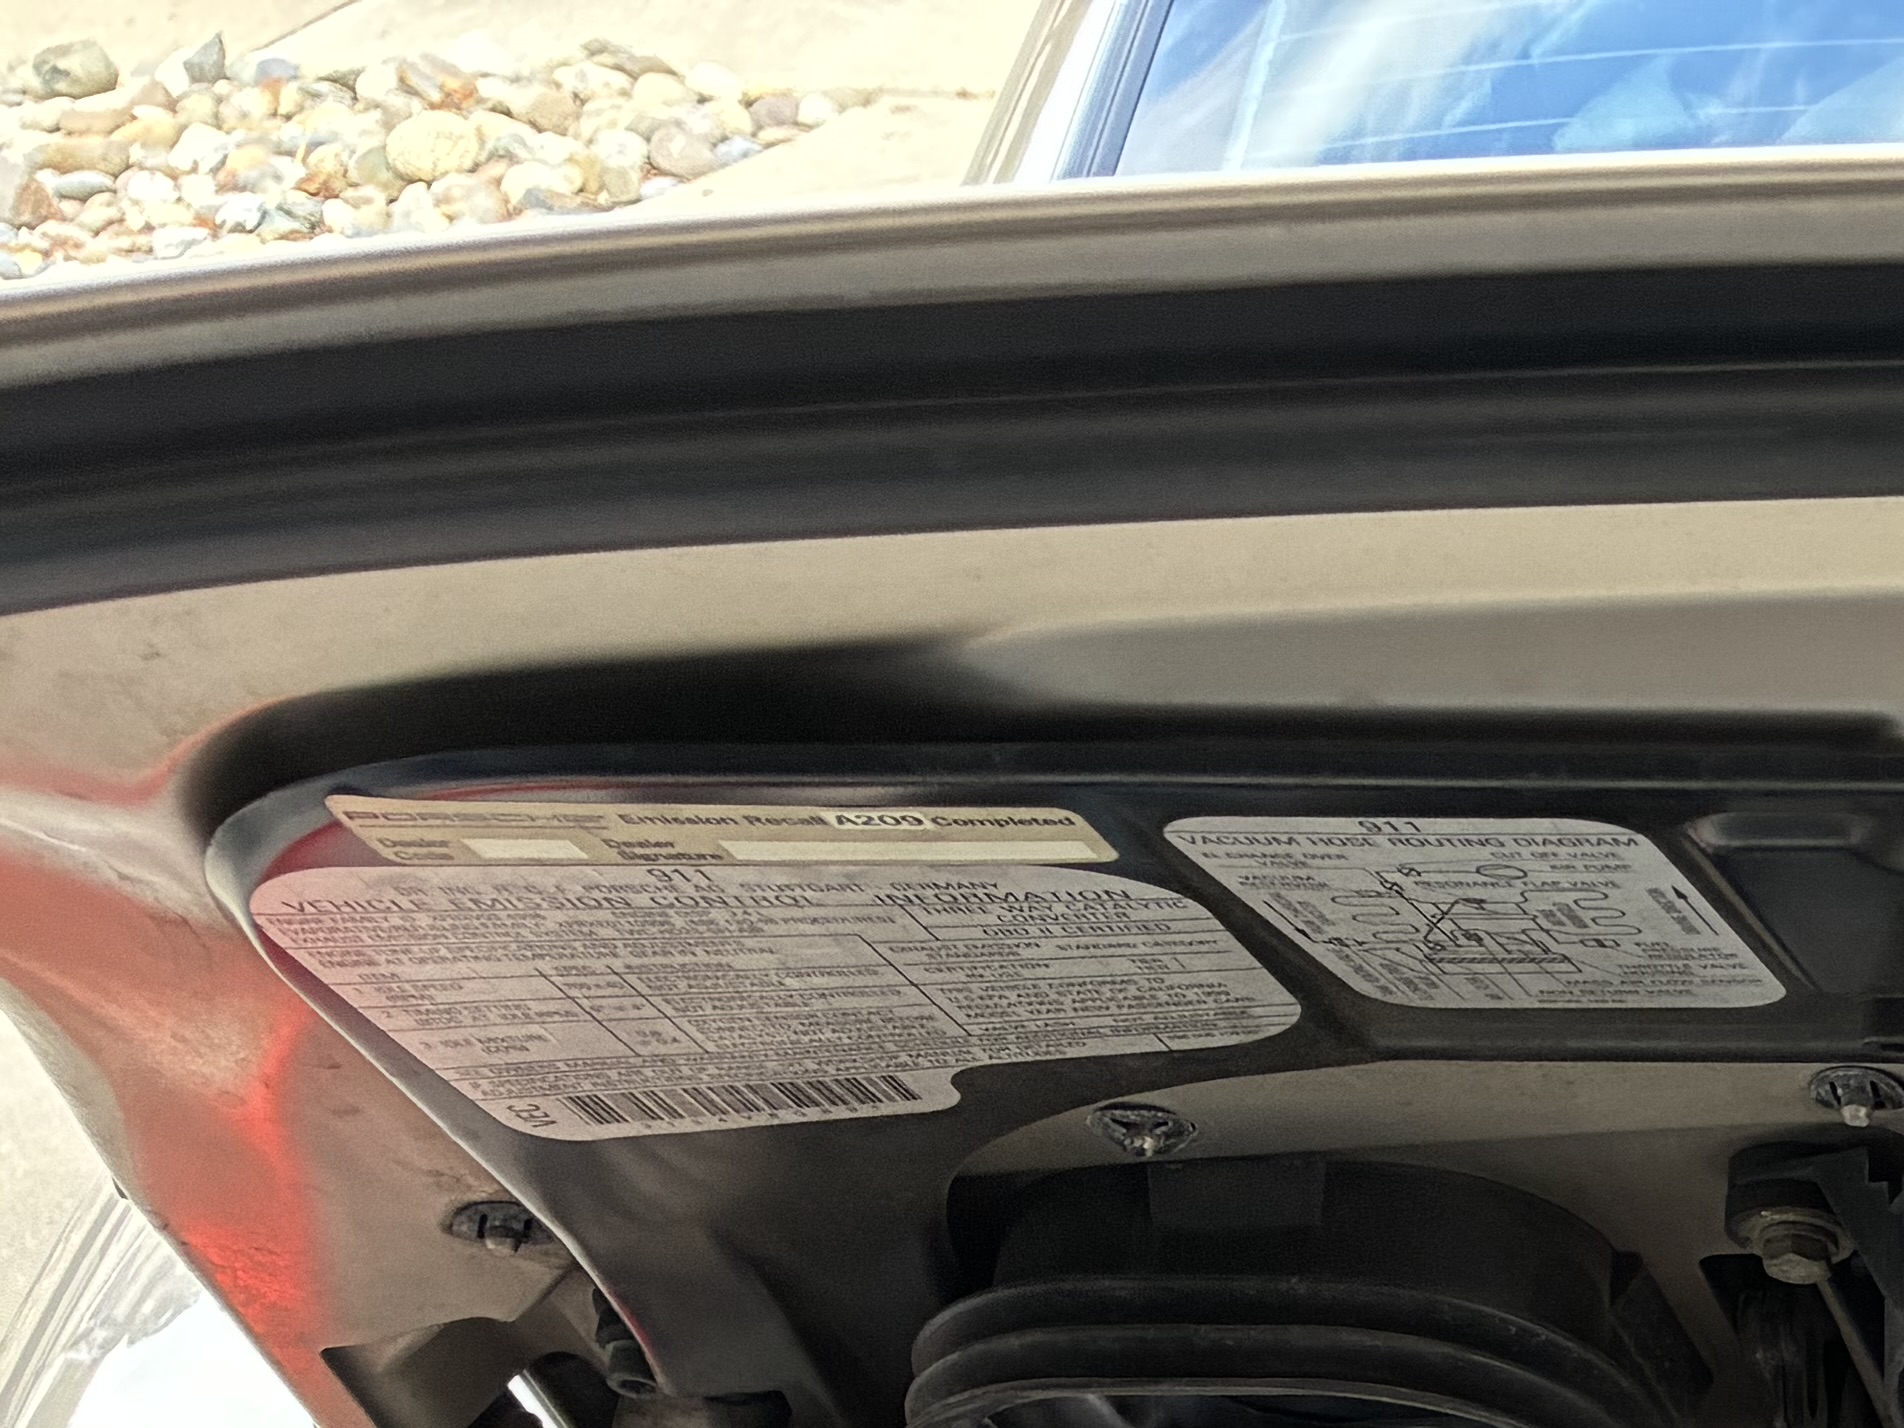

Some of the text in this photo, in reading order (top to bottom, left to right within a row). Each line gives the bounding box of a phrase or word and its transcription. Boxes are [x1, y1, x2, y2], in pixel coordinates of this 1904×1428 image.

[342, 810, 1078, 828] PORSCHE Emission Recall A209 Completed
[1354, 820, 1425, 832] 911
[1177, 835, 1643, 848] VACUUM HOSE ROUTING DIAGRAM
[646, 868, 714, 882] 911
[281, 889, 1133, 912] VEHICLE EMISSION CONTROL INFORMATION
[1064, 899, 1189, 911] CATALYTIC
